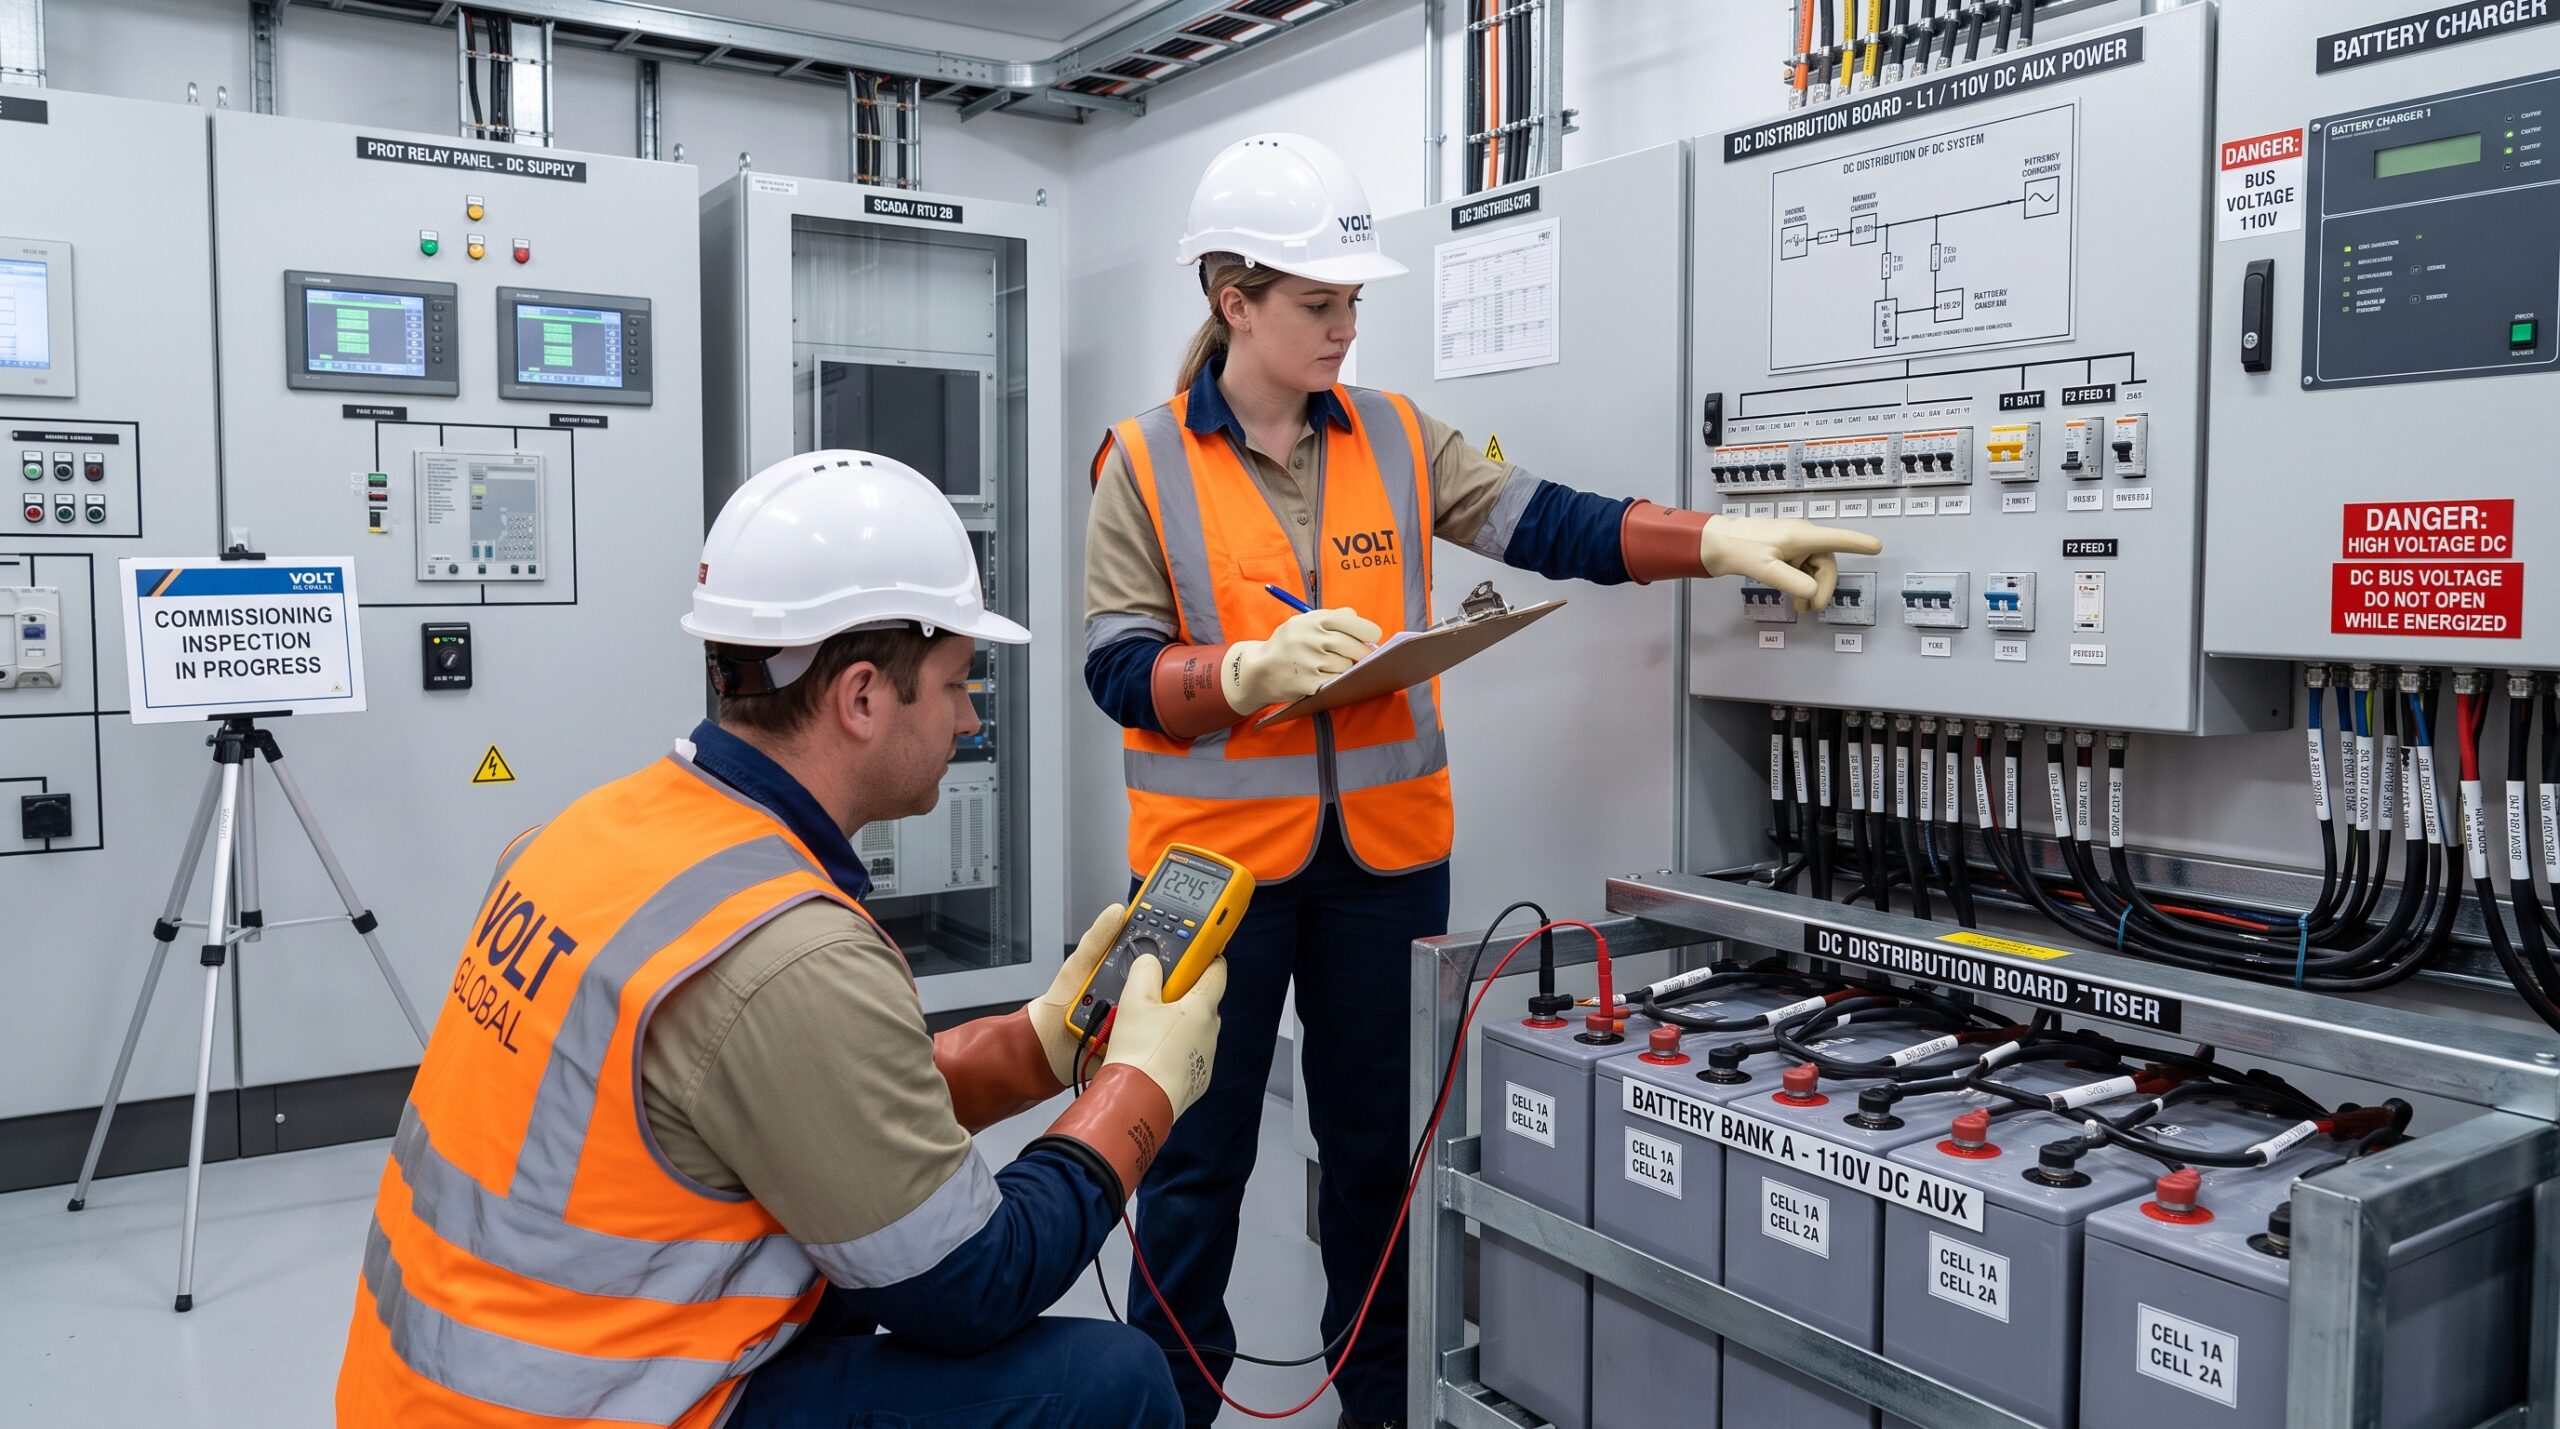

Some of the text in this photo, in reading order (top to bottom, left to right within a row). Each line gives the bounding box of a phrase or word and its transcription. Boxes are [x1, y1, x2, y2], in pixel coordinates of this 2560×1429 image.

[2332, 0, 2548, 63] BATTERY CHARGER
[1733, 134, 1751, 155] DC
[1755, 109, 1848, 151] DISTRIBUTION
[1852, 95, 1902, 131] BOARD
[1917, 87, 1934, 110] L1
[1938, 83, 1947, 105] /
[1951, 72, 1990, 101] 110V
[1994, 67, 2017, 91] DC
[2020, 55, 2057, 84] AUX
[2061, 37, 2128, 74] POWER
[2331, 118, 2375, 136] BATTERY
[2376, 110, 2424, 128] CHARGER
[2426, 108, 2432, 118] 1
[367, 141, 404, 159] PROT
[408, 146, 450, 164] RELAY
[453, 151, 495, 169] PANEL
[507, 157, 524, 172] DC
[527, 160, 576, 178] SUPPLY
[1843, 132, 1985, 175] DC DISTRIBUTION OF DC SYSTEM
[2225, 135, 2300, 166] DANGER:
[2245, 169, 2276, 189] BUS
[873, 198, 953, 219] SCADA / RTU 2B
[2226, 186, 2294, 212] VOLTAGE
[1337, 214, 1372, 233] VOLT
[2240, 211, 2278, 231] 110V
[2003, 393, 2042, 408] F1 BATT
[2065, 388, 2111, 403] F2 FEED 1
[2366, 505, 2488, 532] DANGER:
[1331, 529, 1394, 557] VOLT
[2066, 542, 2113, 553] F2 FEED 1
[2347, 535, 2507, 553] HIGH VOLTAGE DC
[1340, 553, 1398, 571] GLOBAL
[288, 572, 335, 585] VOLT
[2350, 569, 2503, 587] DC BUS VOLTAGE
[2364, 591, 2486, 609] DO NOT OPEN
[154, 606, 333, 629] COMMISSIONING
[2343, 612, 2507, 632] WHILE ENERGIZED
[181, 631, 312, 653] INSPECTION
[175, 656, 322, 680] IN PROGRESS
[476, 879, 579, 1003] VOLT
[1818, 930, 1843, 956] DC
[1847, 938, 1987, 987] DISTRIBUTION
[1993, 966, 2069, 1004] BOARD
[453, 956, 522, 1055] GLOBAL
[1512, 1093, 1549, 1118] CELL 1A
[1512, 1111, 1549, 1136] CELL 2A
[1632, 1085, 1715, 1133] BATTERY
[1721, 1114, 1775, 1155] BANK
[1780, 1135, 1796, 1162] A
[1816, 1147, 1871, 1186] 110V
[1878, 1165, 1910, 1199] DC
[1916, 1179, 1968, 1220] AUX
[1632, 1139, 1675, 1166] CELL 1A
[1632, 1158, 1675, 1186] CELL 2A
[1770, 1191, 1820, 1222] CELL 1A
[1770, 1212, 1820, 1243] CELL 2A
[1940, 1248, 1998, 1283] CELL 1A
[1939, 1271, 1997, 1306] CELL 2A
[2151, 1323, 2224, 1364] CELL 1A
[2150, 1347, 2223, 1389] CELL 2A
